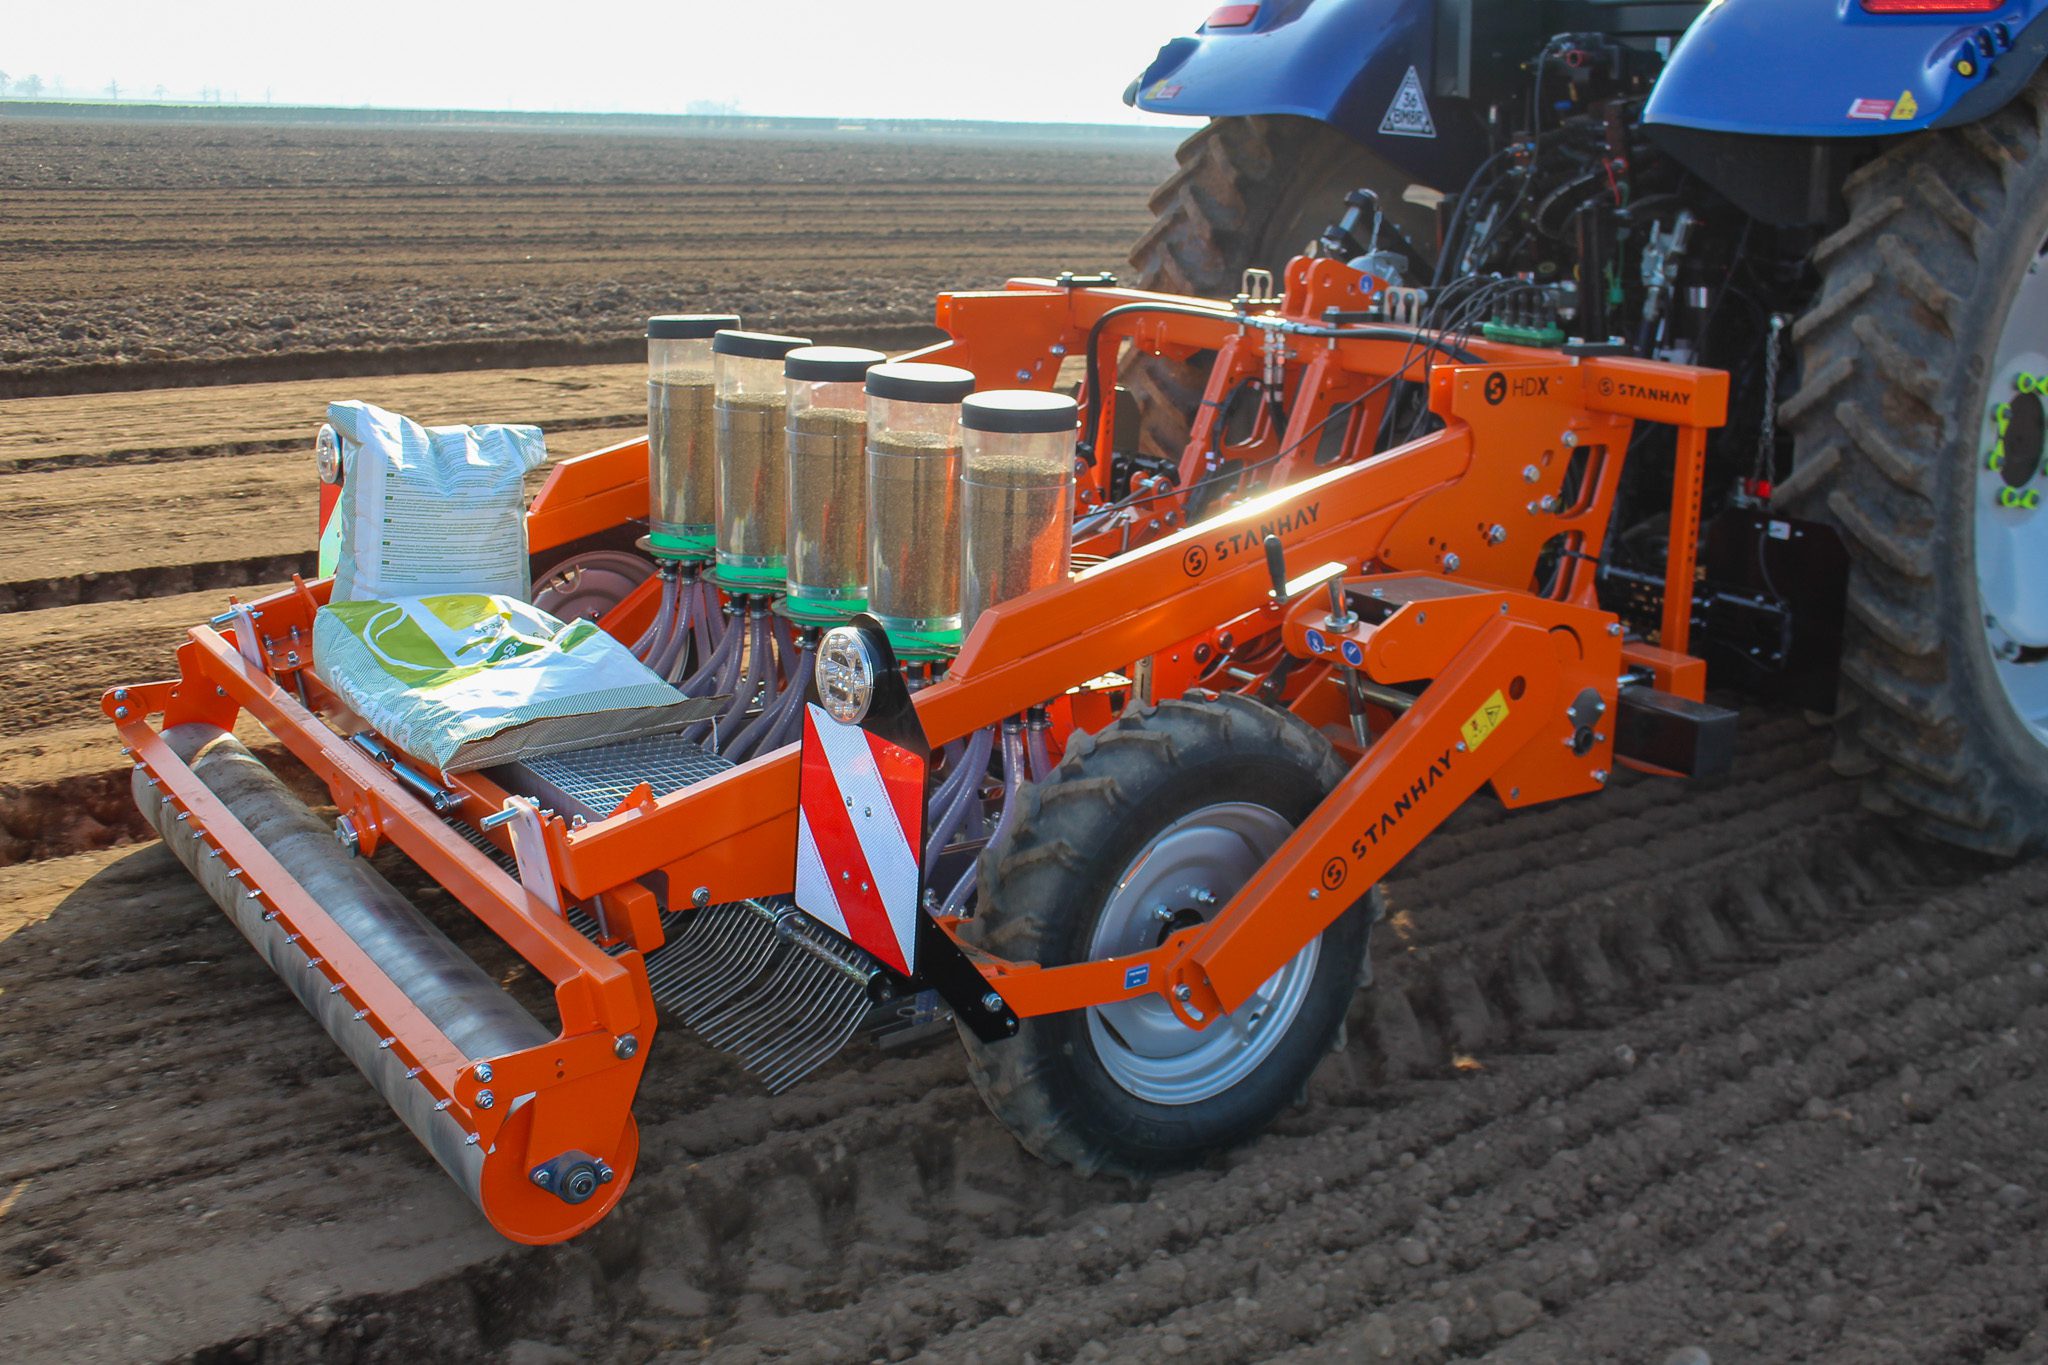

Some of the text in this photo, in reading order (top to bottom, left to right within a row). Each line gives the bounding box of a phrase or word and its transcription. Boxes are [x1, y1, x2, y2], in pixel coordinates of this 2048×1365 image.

[1512, 376, 1550, 397] HDX
[1618, 383, 1691, 406] STANHAY
[1214, 501, 1321, 561] STANHAY
[1351, 748, 1451, 861] STANHAY
